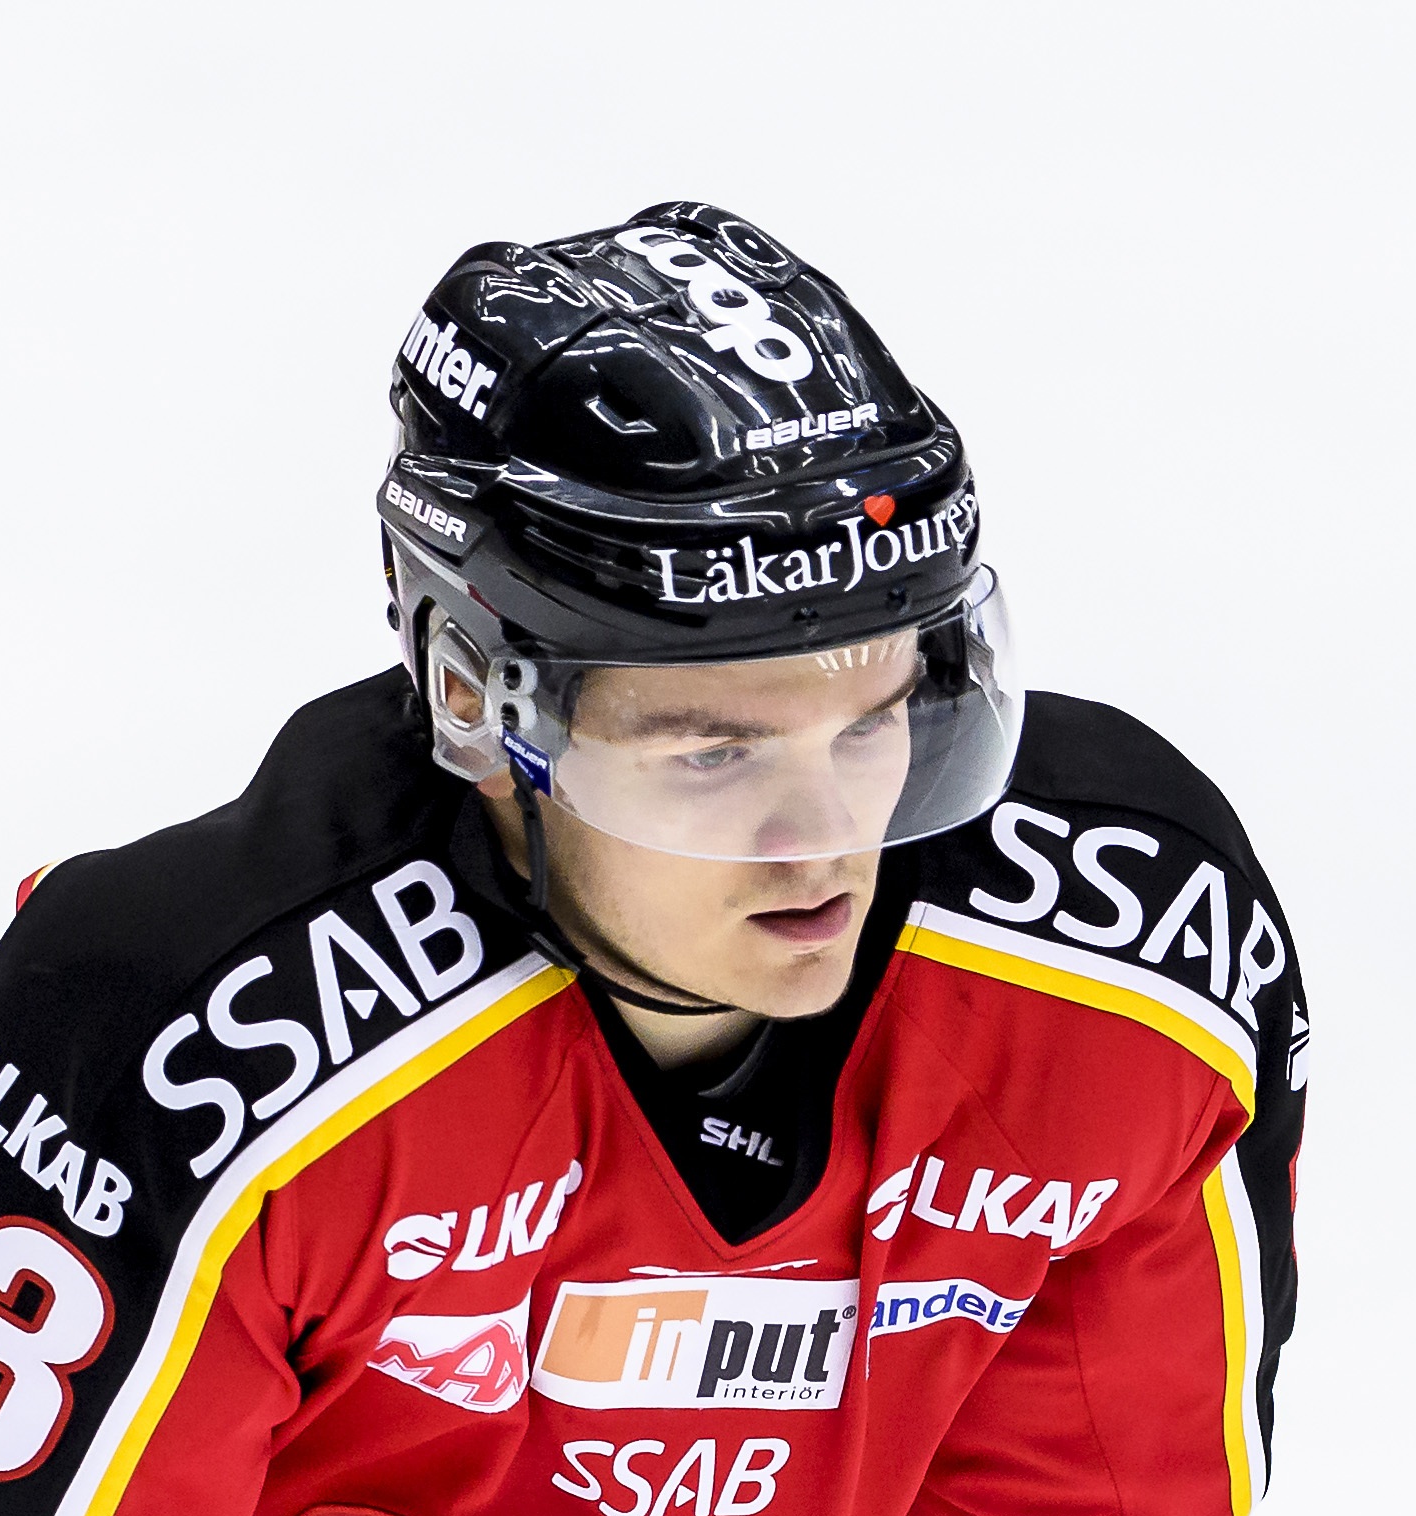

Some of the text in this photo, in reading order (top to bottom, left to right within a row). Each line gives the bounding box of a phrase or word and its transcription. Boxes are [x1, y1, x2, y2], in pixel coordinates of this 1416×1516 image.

[745, 402, 880, 451] BAUER
[386, 479, 466, 544] BAUER
[142, 859, 484, 1180] SSAB
[700, 1117, 785, 1167] SHL
[451, 1158, 583, 1271] LKA
[910, 1155, 1119, 1250] LKAB
[723, 1383, 826, 1401] interiör
